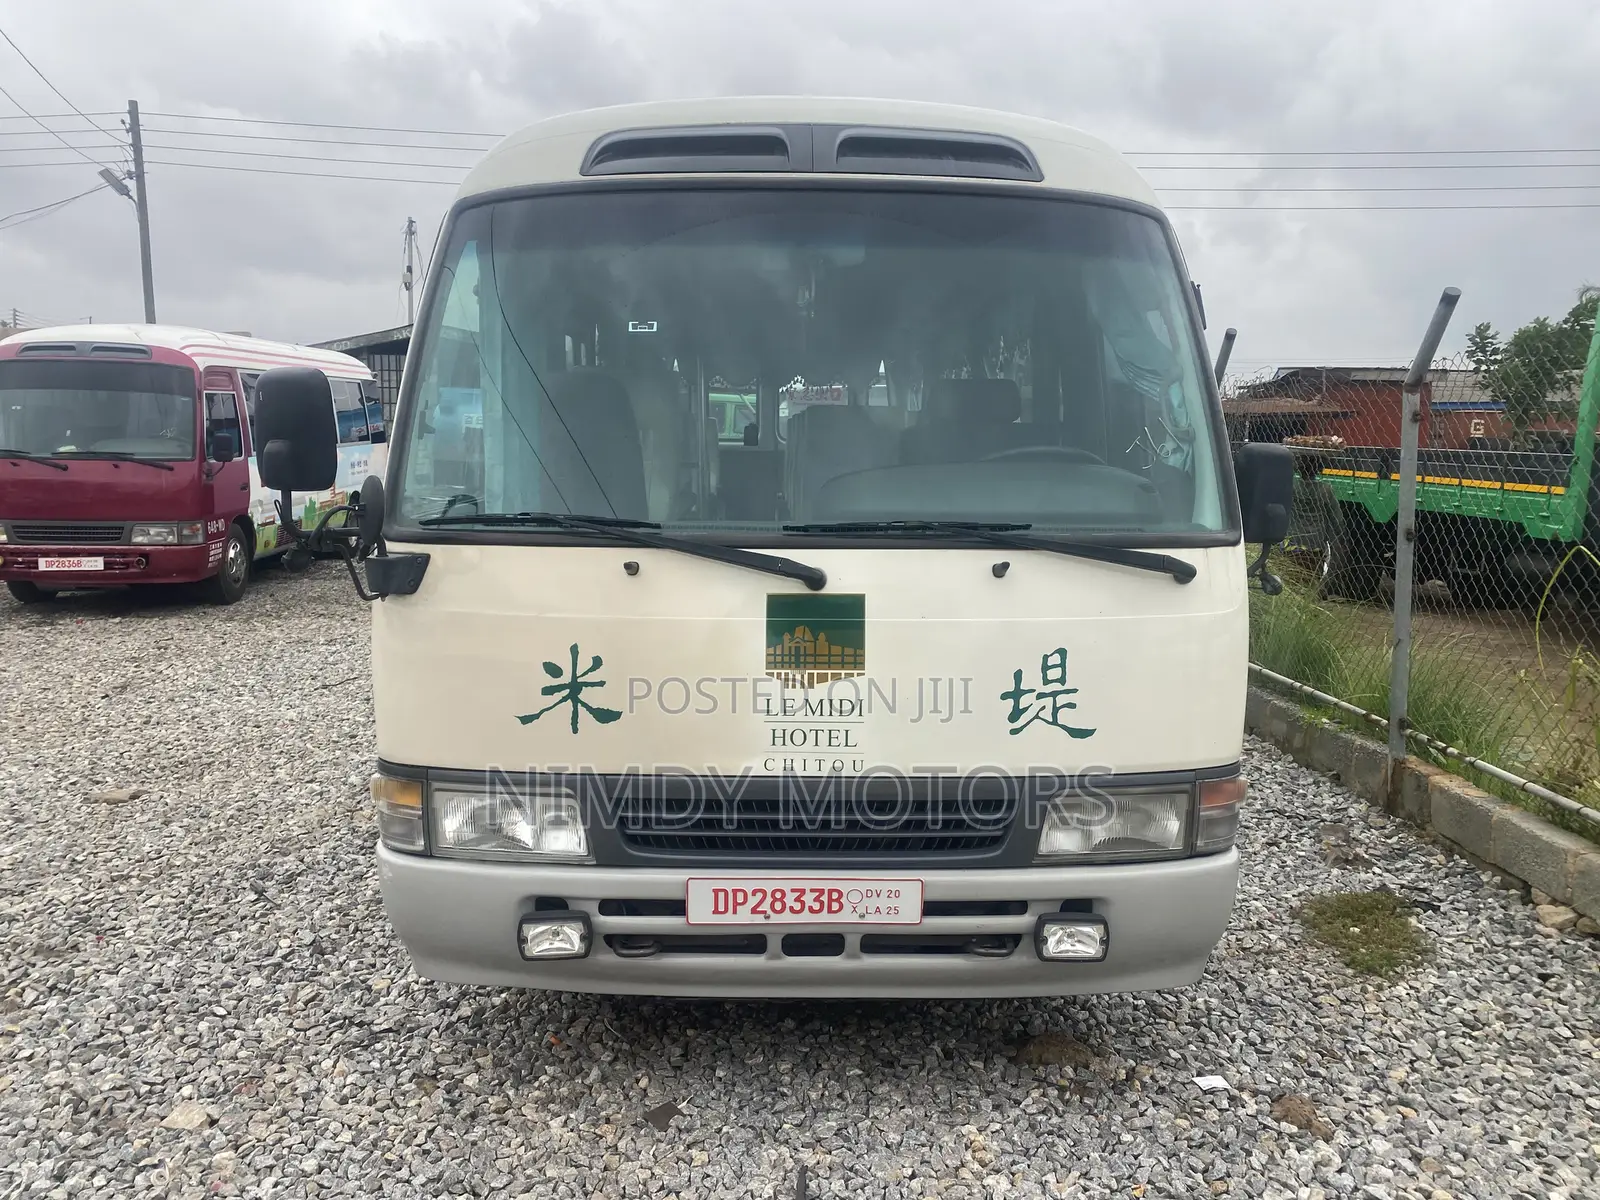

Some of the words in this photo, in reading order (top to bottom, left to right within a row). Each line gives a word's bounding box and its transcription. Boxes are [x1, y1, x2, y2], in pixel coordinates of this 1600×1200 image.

[45, 560, 82, 568] DP2836B
[514, 643, 623, 735] 米
[1000, 647, 1097, 738] 堤
[765, 698, 796, 717] LE
[804, 698, 864, 717] MIDI
[770, 728, 858, 748] HOTEL
[763, 758, 865, 773] CHITOU
[711, 888, 844, 915] DP2833B
[865, 889, 882, 899] DV
[886, 889, 901, 899] 20
[865, 906, 882, 915] LA
[886, 906, 900, 915] 25
